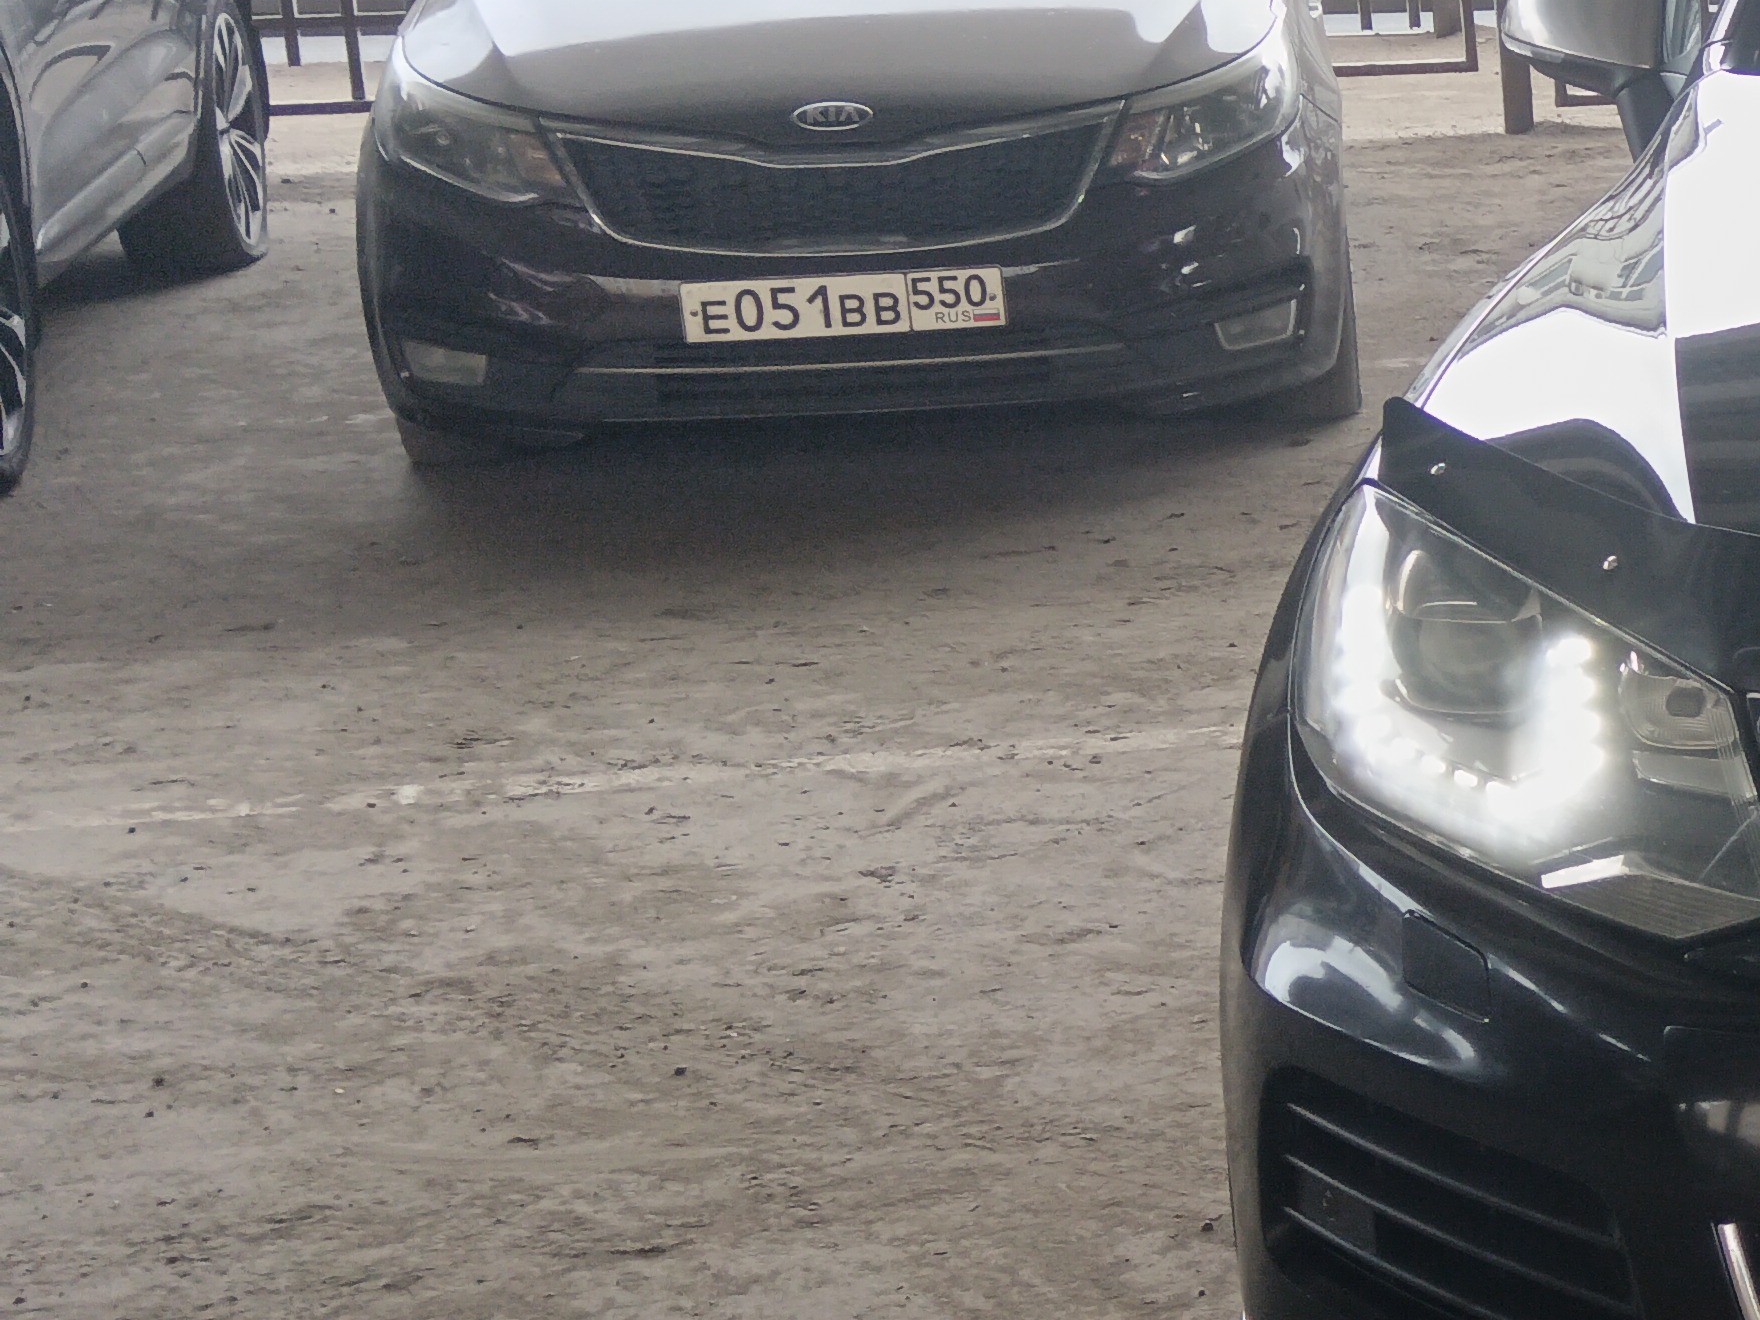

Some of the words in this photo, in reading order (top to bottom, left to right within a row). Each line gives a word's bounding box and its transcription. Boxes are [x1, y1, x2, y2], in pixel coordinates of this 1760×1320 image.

[806, 106, 860, 124] KIA
[700, 284, 901, 335] Е051ВВ
[910, 273, 988, 311] 550
[935, 309, 972, 325] RUS
